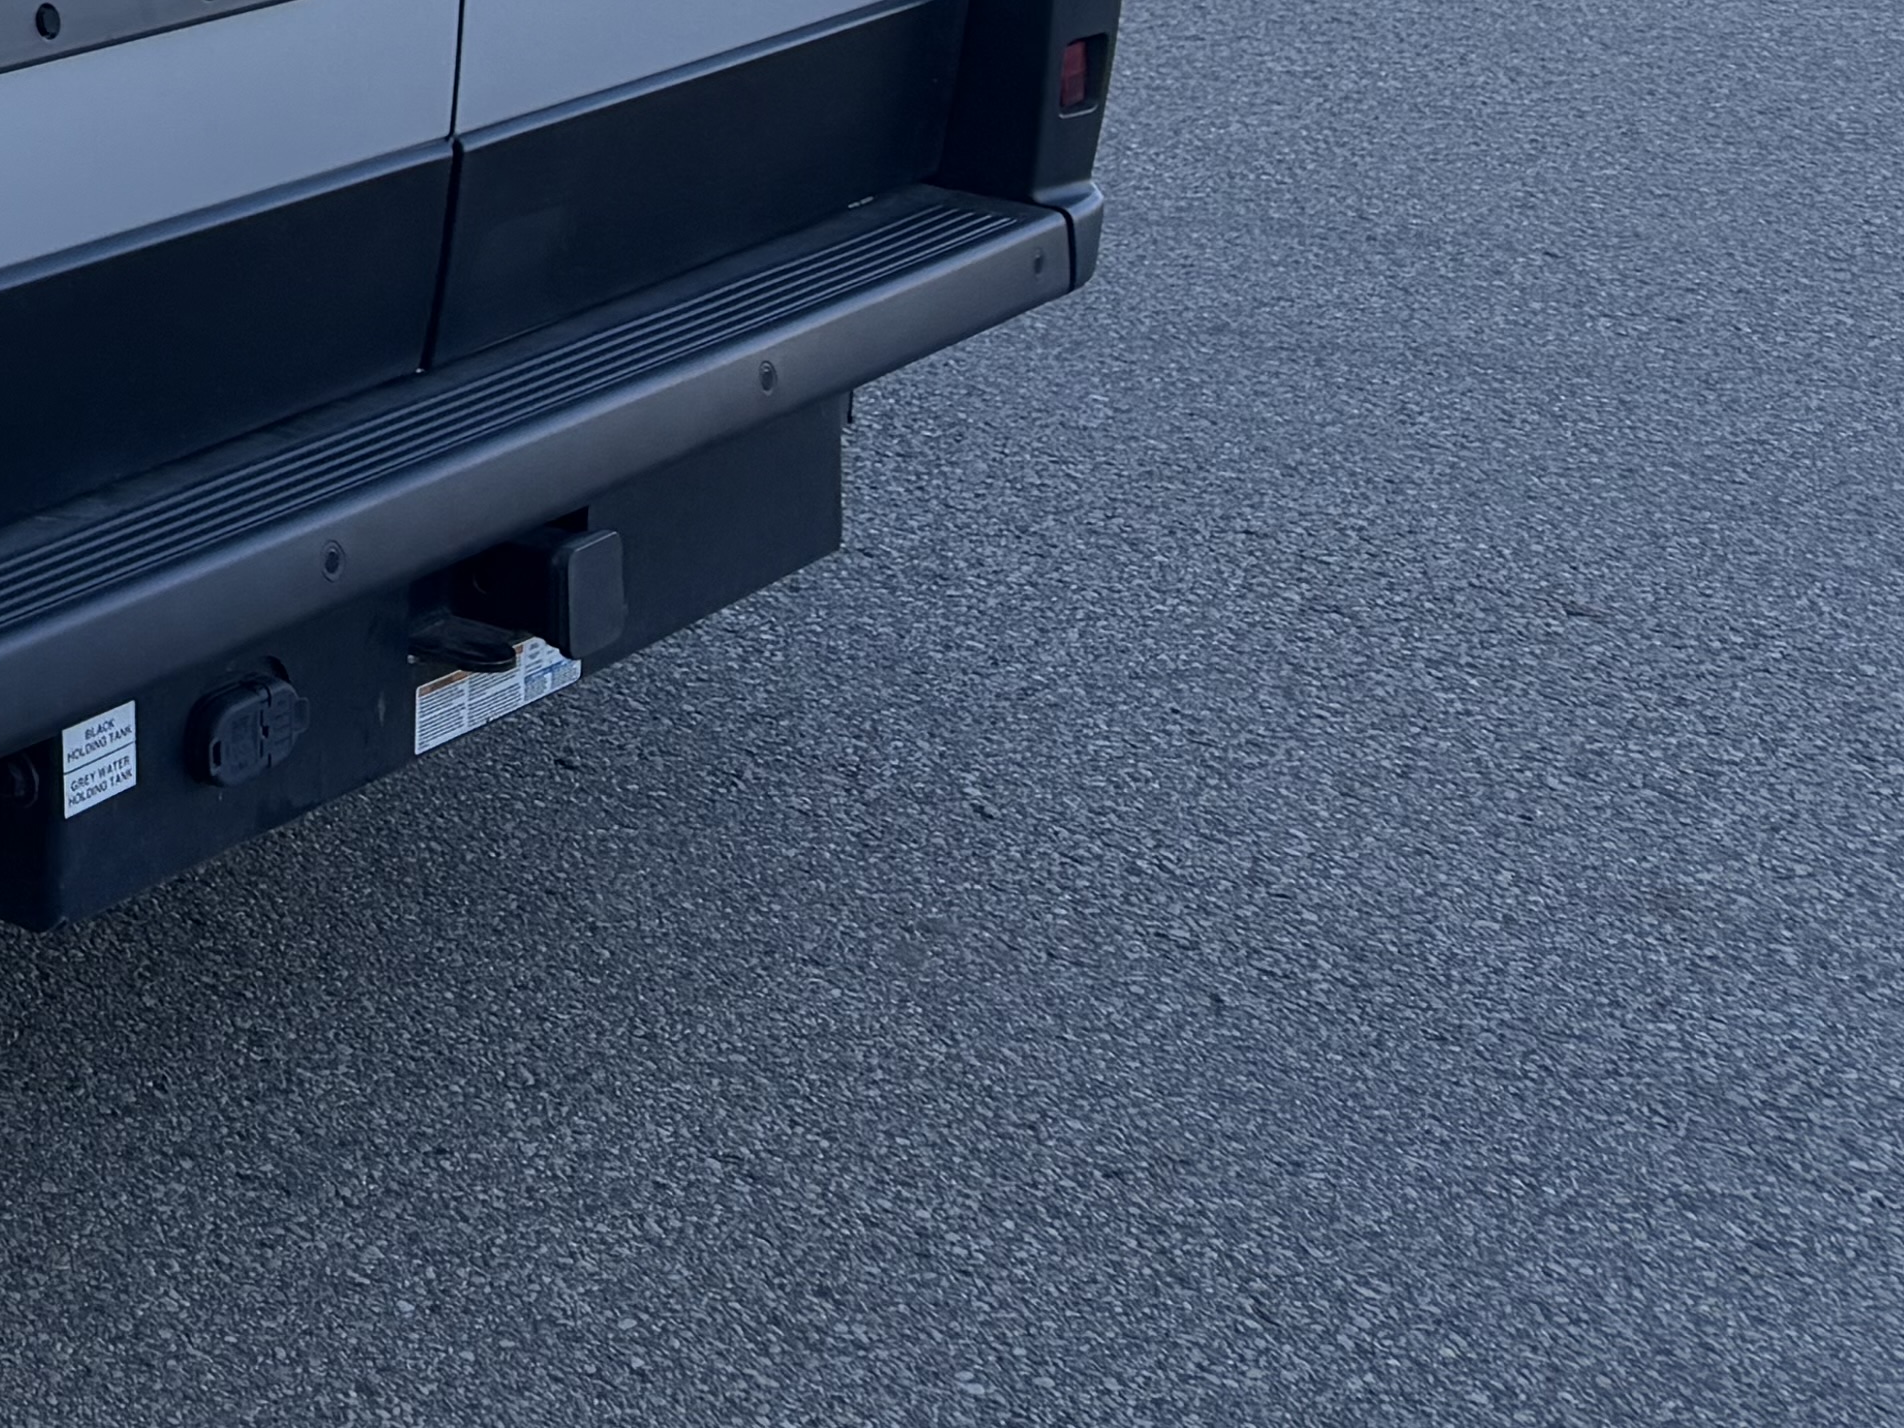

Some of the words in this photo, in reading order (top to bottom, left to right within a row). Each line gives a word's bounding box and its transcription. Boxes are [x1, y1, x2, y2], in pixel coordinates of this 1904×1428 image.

[67, 735, 107, 763] HOLDING
[109, 725, 132, 743] TANK
[85, 718, 115, 740] BLACK
[68, 780, 107, 807] HOLDING
[109, 769, 133, 787] TANK
[71, 772, 95, 792] GREY
[98, 755, 131, 778] WATER
